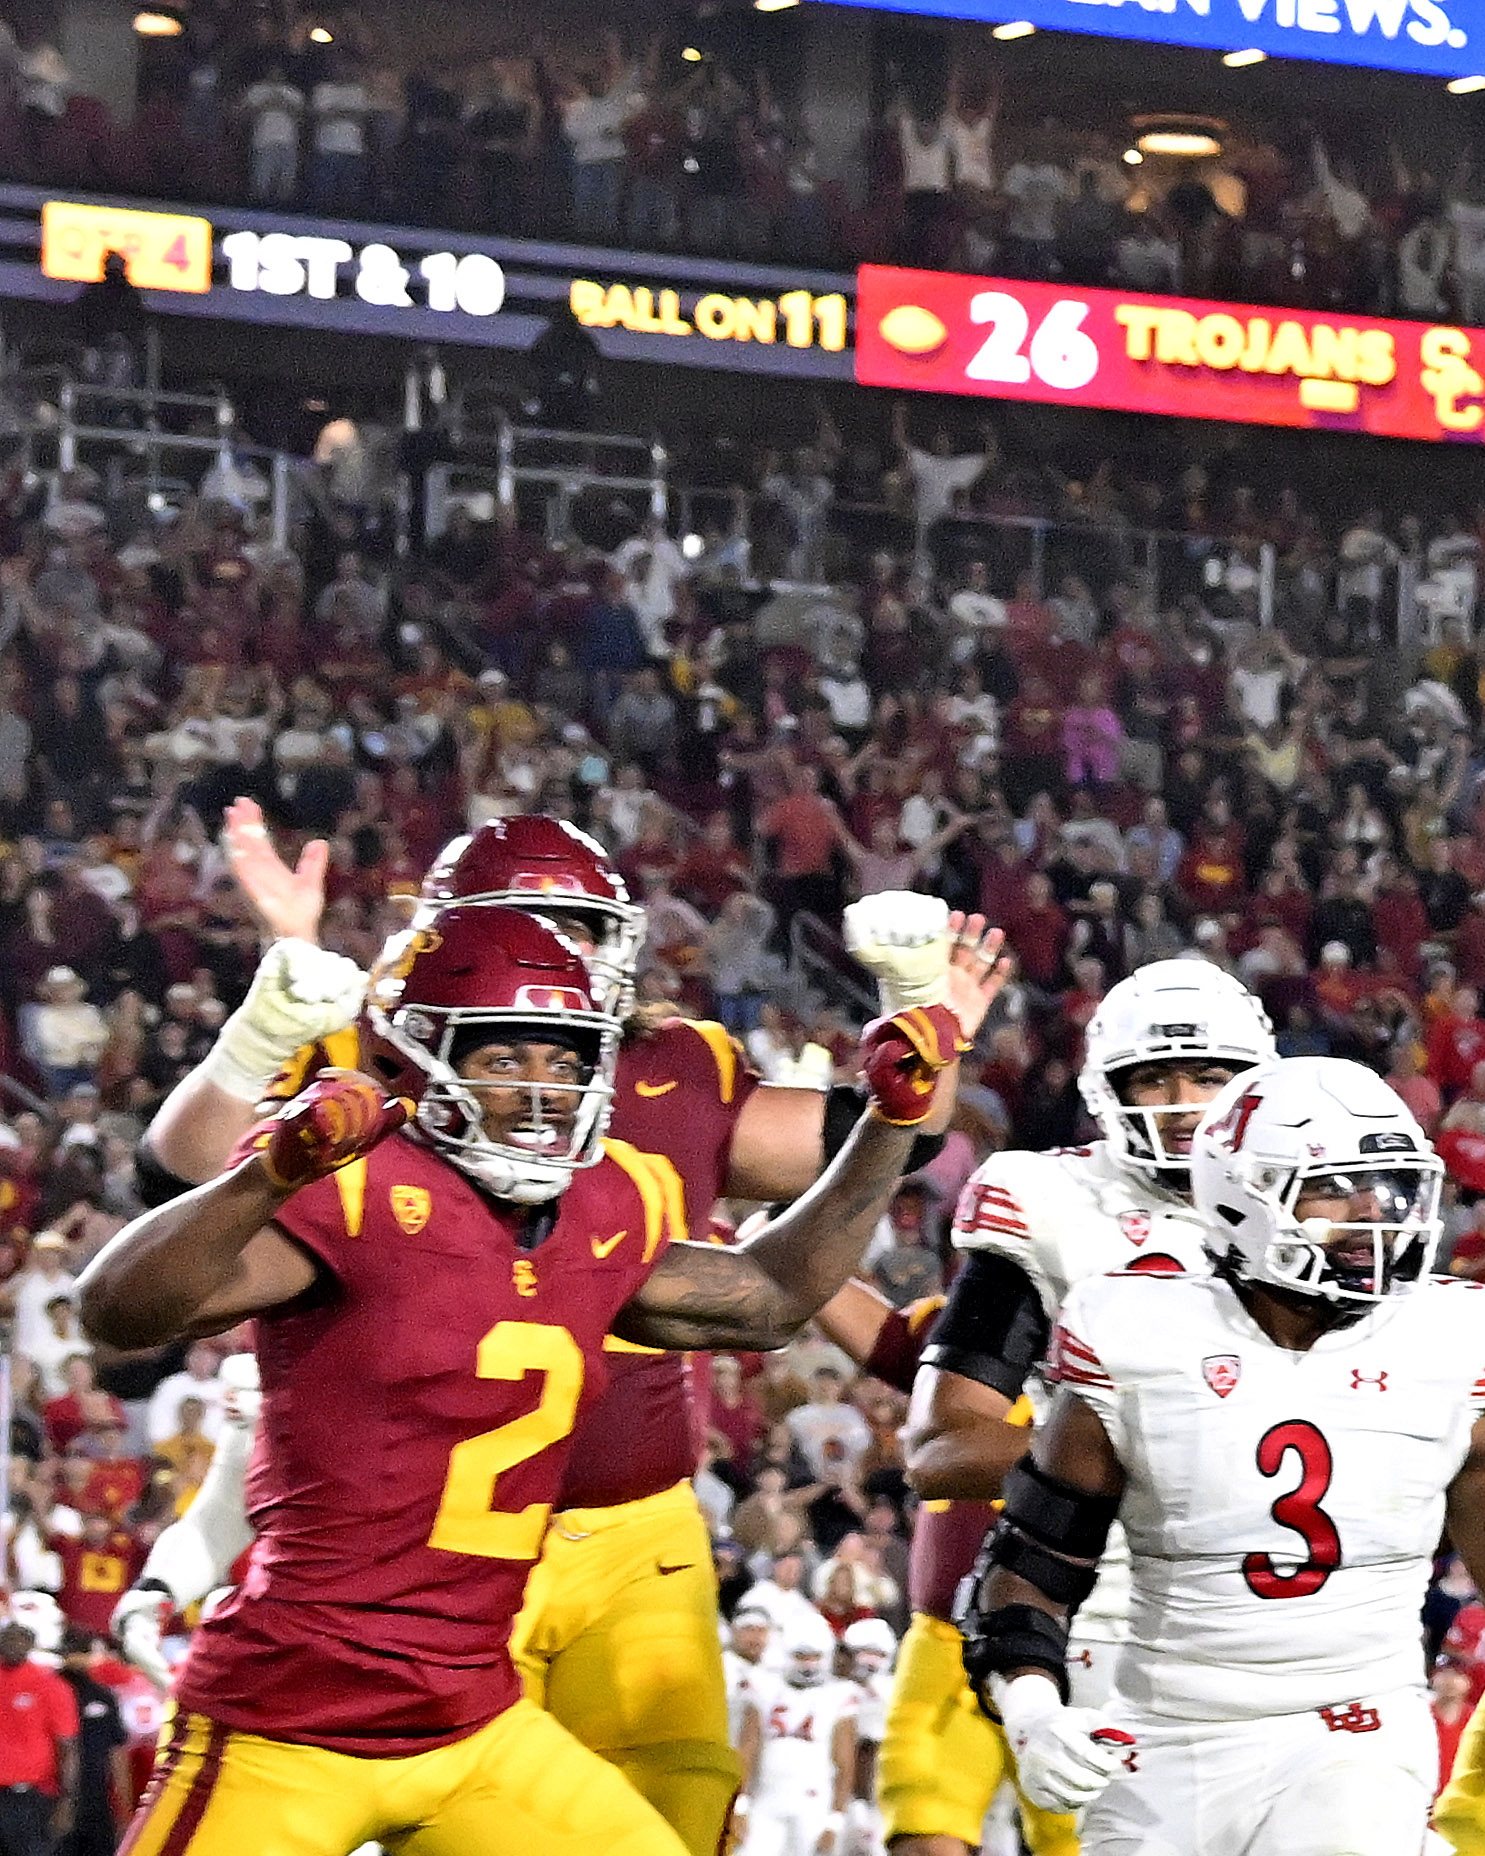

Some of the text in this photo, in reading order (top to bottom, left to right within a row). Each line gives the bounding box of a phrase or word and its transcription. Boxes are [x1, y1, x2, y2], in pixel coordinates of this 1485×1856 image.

[162, 234, 191, 273] 4
[222, 231, 505, 316] 1ST & 10
[569, 280, 848, 352] BALL ON 11
[965, 291, 1099, 390] 26
[1114, 303, 1397, 385] TROJANS
[427, 1320, 586, 1562] 2
[1242, 1418, 1344, 1600] 3
